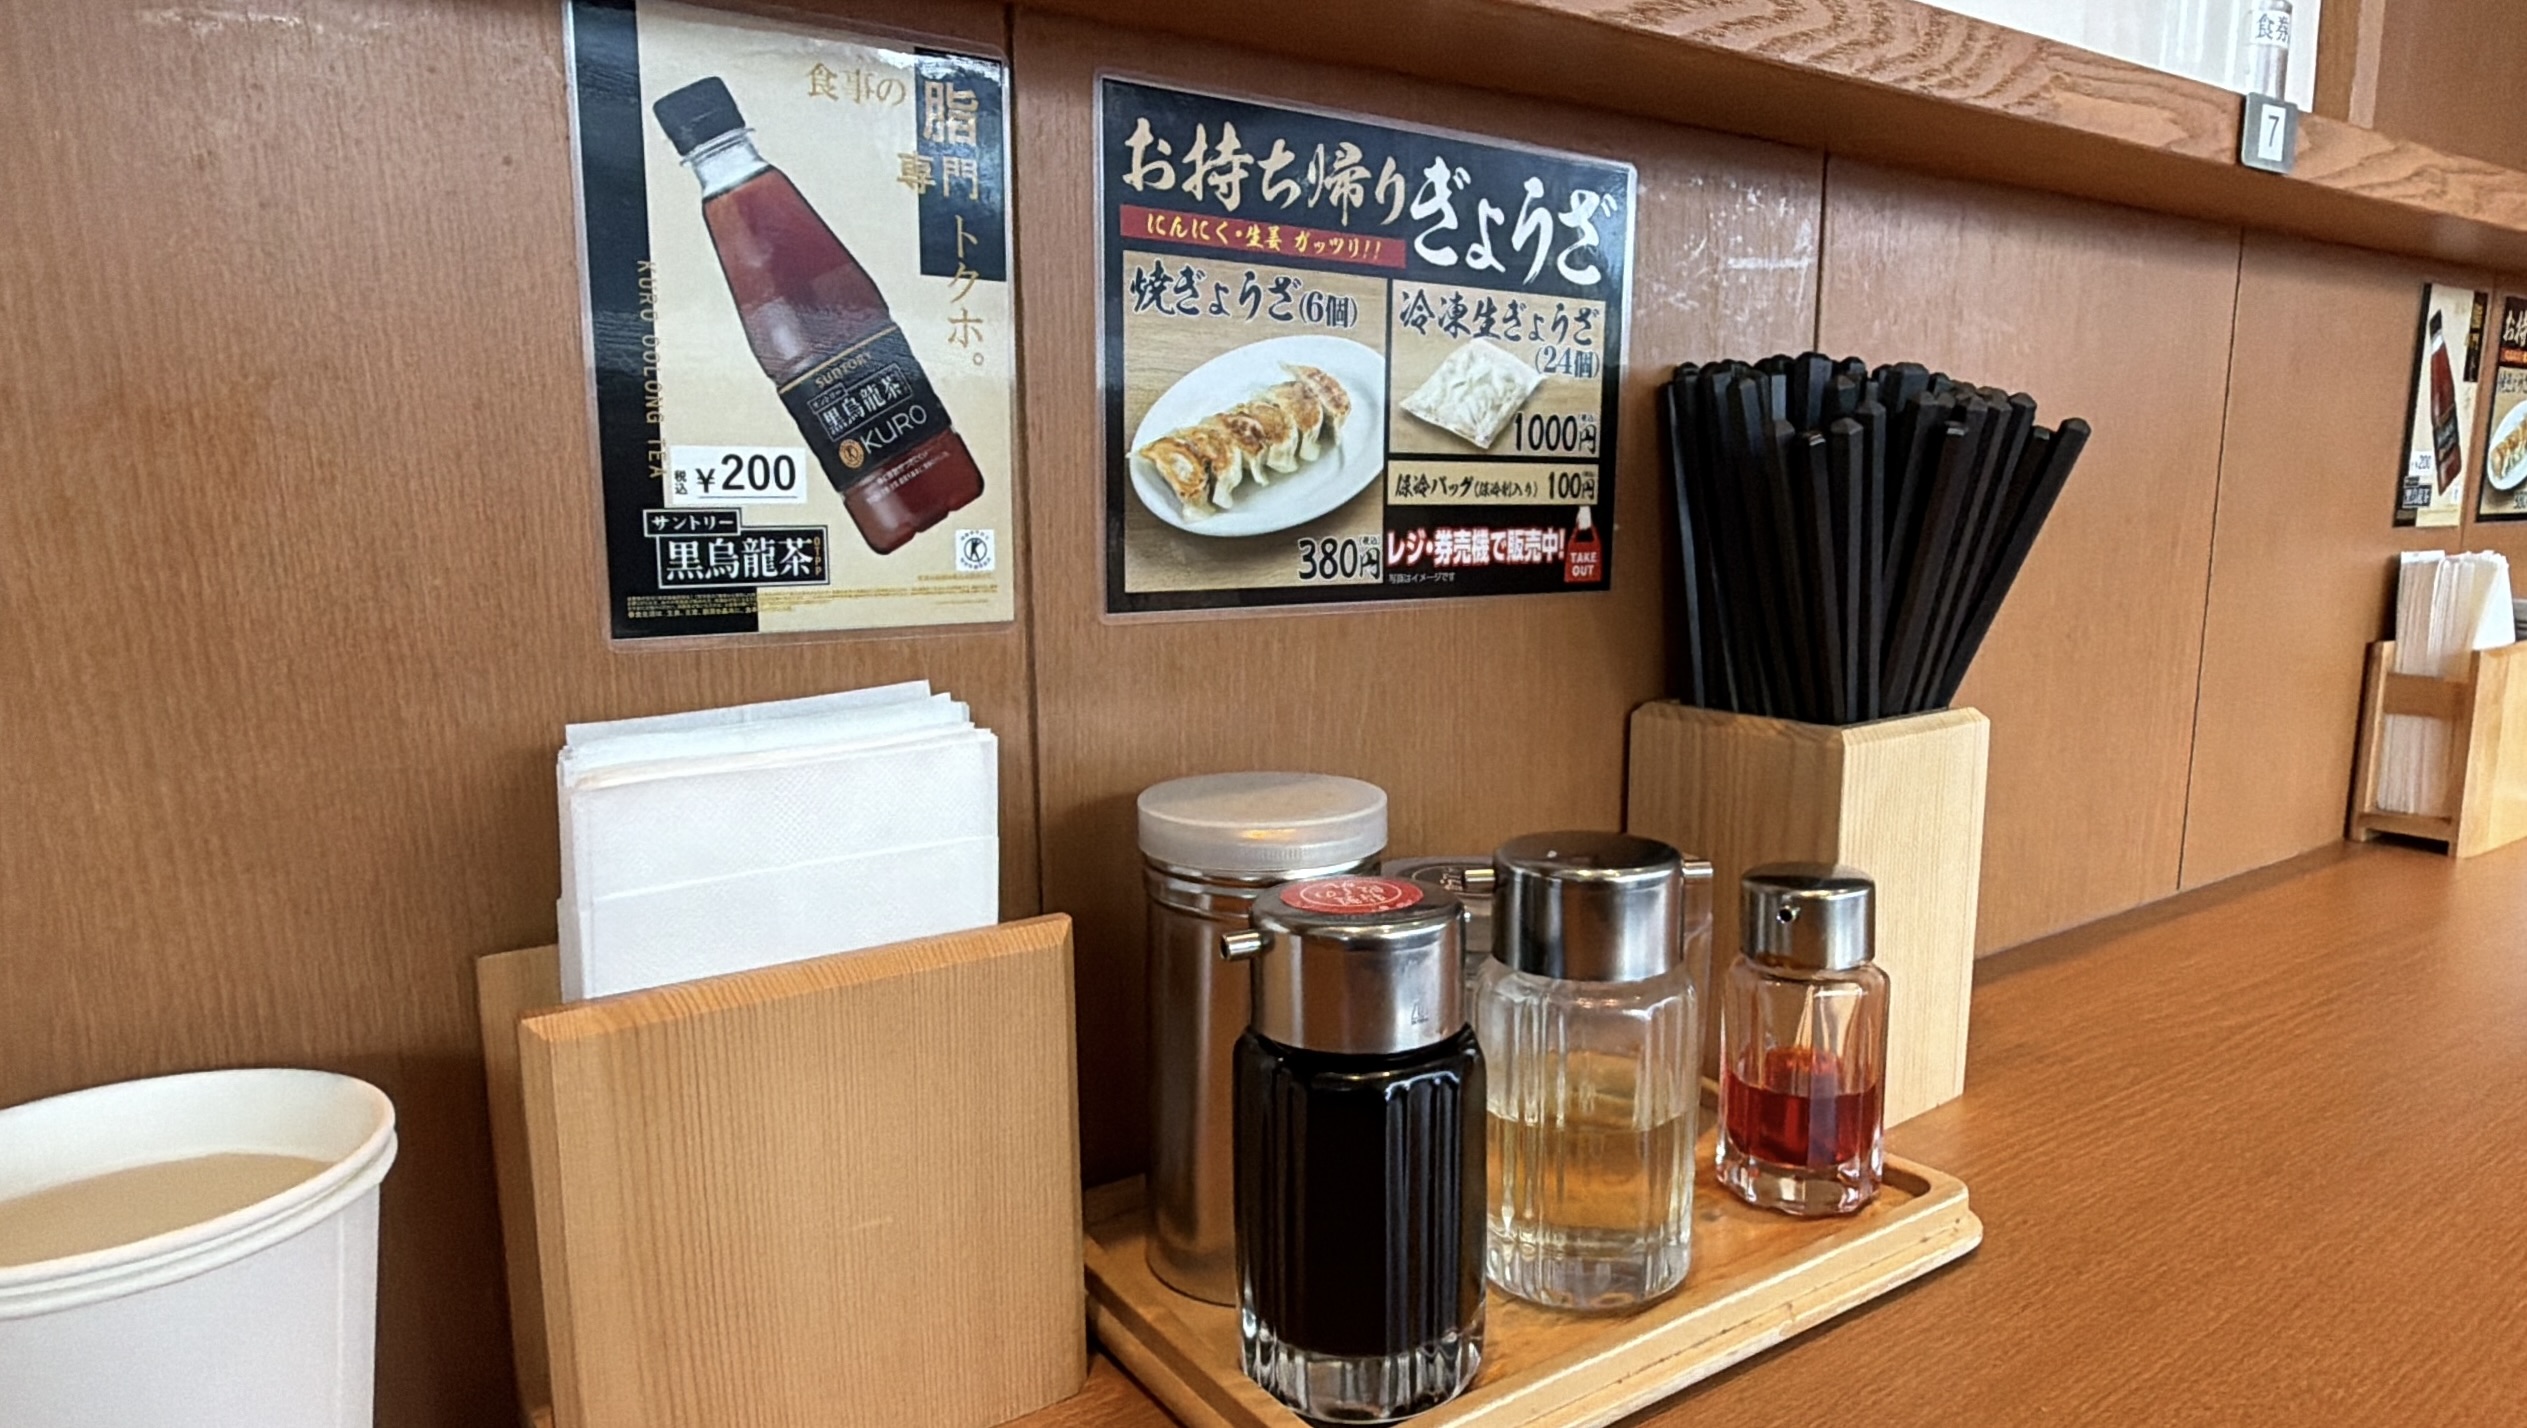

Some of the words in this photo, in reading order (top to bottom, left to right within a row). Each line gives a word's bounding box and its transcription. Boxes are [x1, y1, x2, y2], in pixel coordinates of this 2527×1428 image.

[2268, 114, 2280, 148] 7
[897, 151, 979, 200] 専門
[1122, 117, 1406, 227] お持ち帰り
[1409, 155, 1619, 287] ぎょうざ
[637, 260, 658, 323] KURO
[947, 213, 986, 368] トクホ。
[1400, 288, 1602, 347] 冷凍生ぎょうざ
[641, 333, 665, 424] OOLONG
[859, 404, 928, 455] KURO
[1514, 412, 1598, 454] 1000円
[648, 438, 667, 479] TEA
[674, 470, 688, 496] 税込
[695, 453, 797, 494] ¥200
[651, 515, 735, 532] サントリー
[666, 537, 813, 581] 黒烏龍茶
[1298, 538, 1382, 580] 380円
[1570, 551, 1597, 564] TAKE
[1571, 565, 1595, 578] OUT
